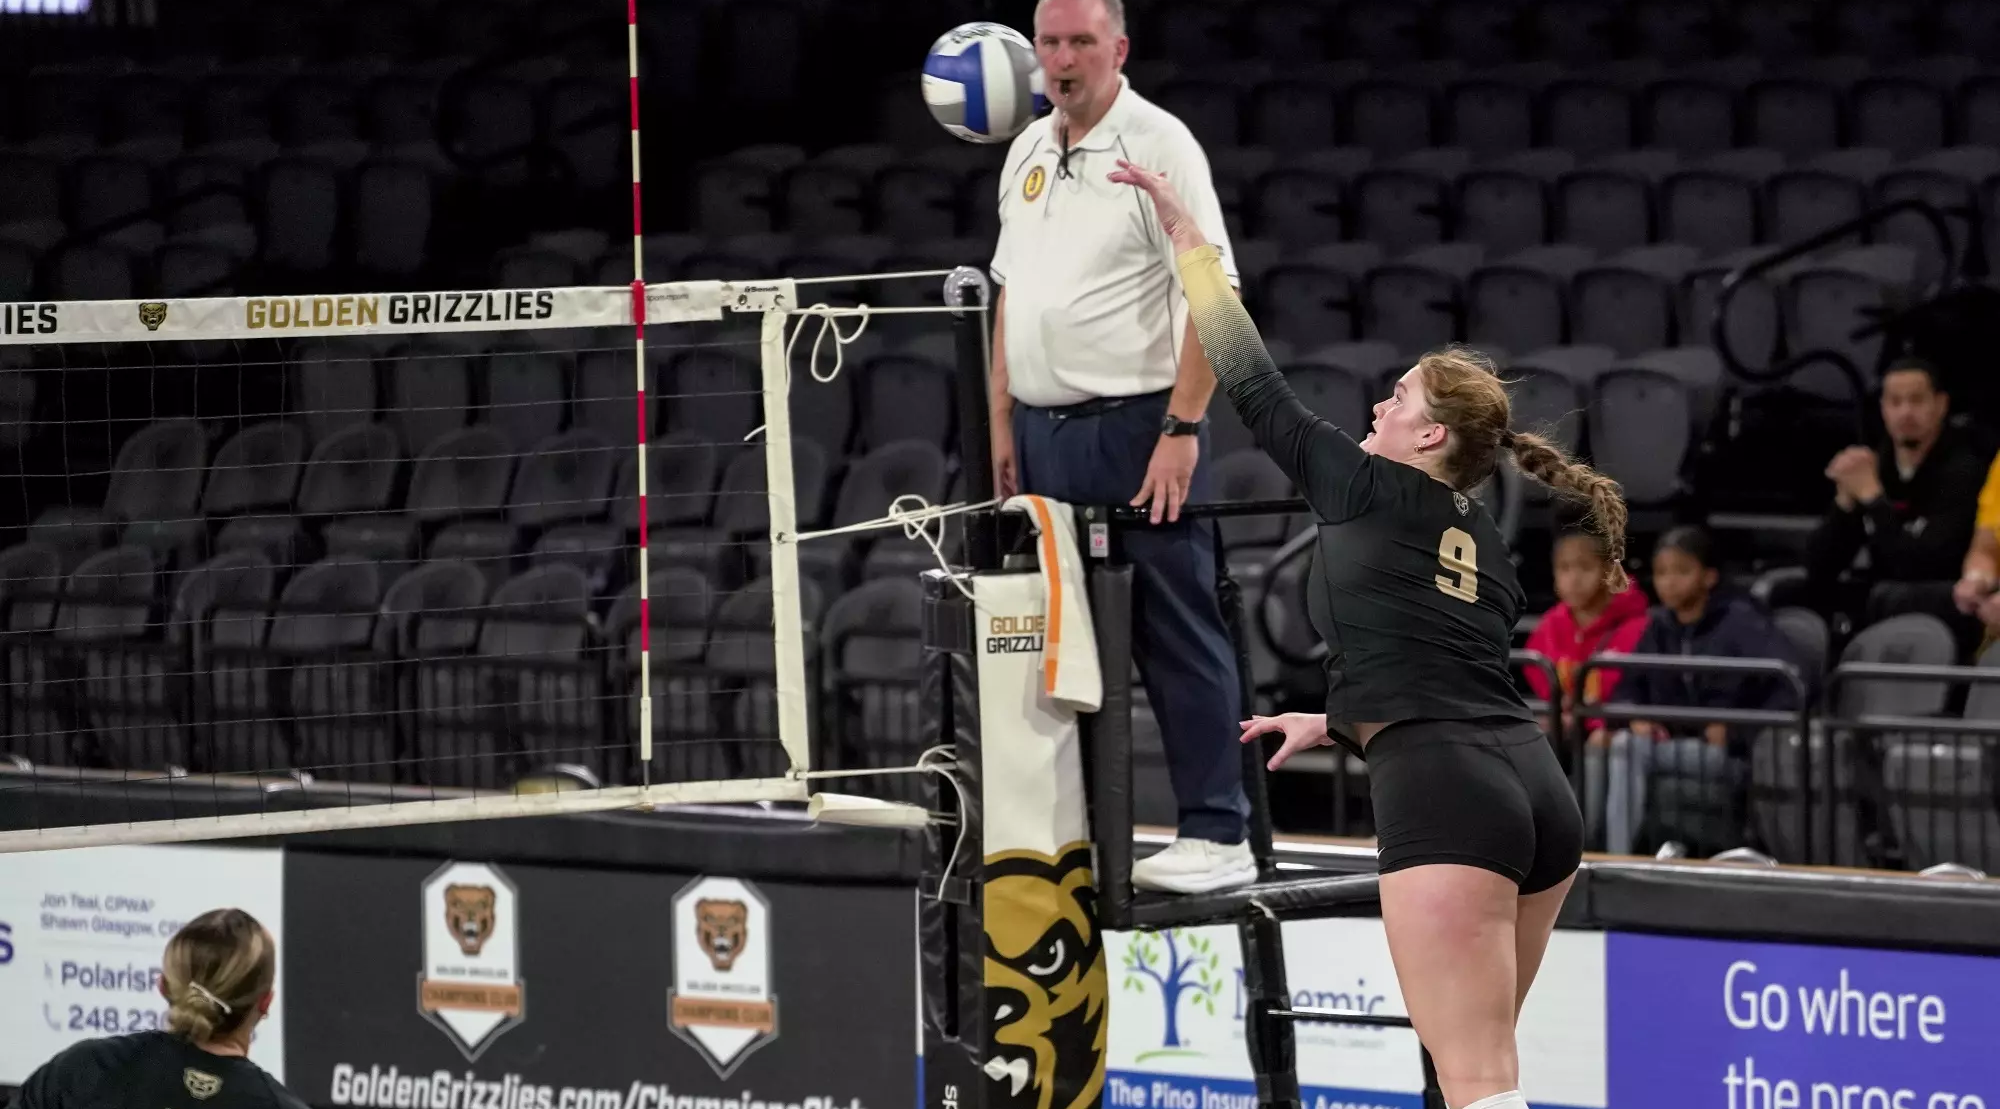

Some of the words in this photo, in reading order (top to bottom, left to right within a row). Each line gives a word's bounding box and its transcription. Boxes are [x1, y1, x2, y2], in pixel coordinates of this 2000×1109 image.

[0, 303, 57, 335] IES
[246, 297, 379, 329] GOLDEN
[388, 290, 553, 325] GRIZZLIES
[1435, 526, 1480, 604] 9
[991, 615, 1045, 634] GOLDE
[986, 635, 1043, 654] GRIZZLI
[1724, 961, 1790, 1032] Go
[1798, 968, 1946, 1044] where
[1109, 1078, 1147, 1108] The
[1151, 1081, 1199, 1109] Pino
